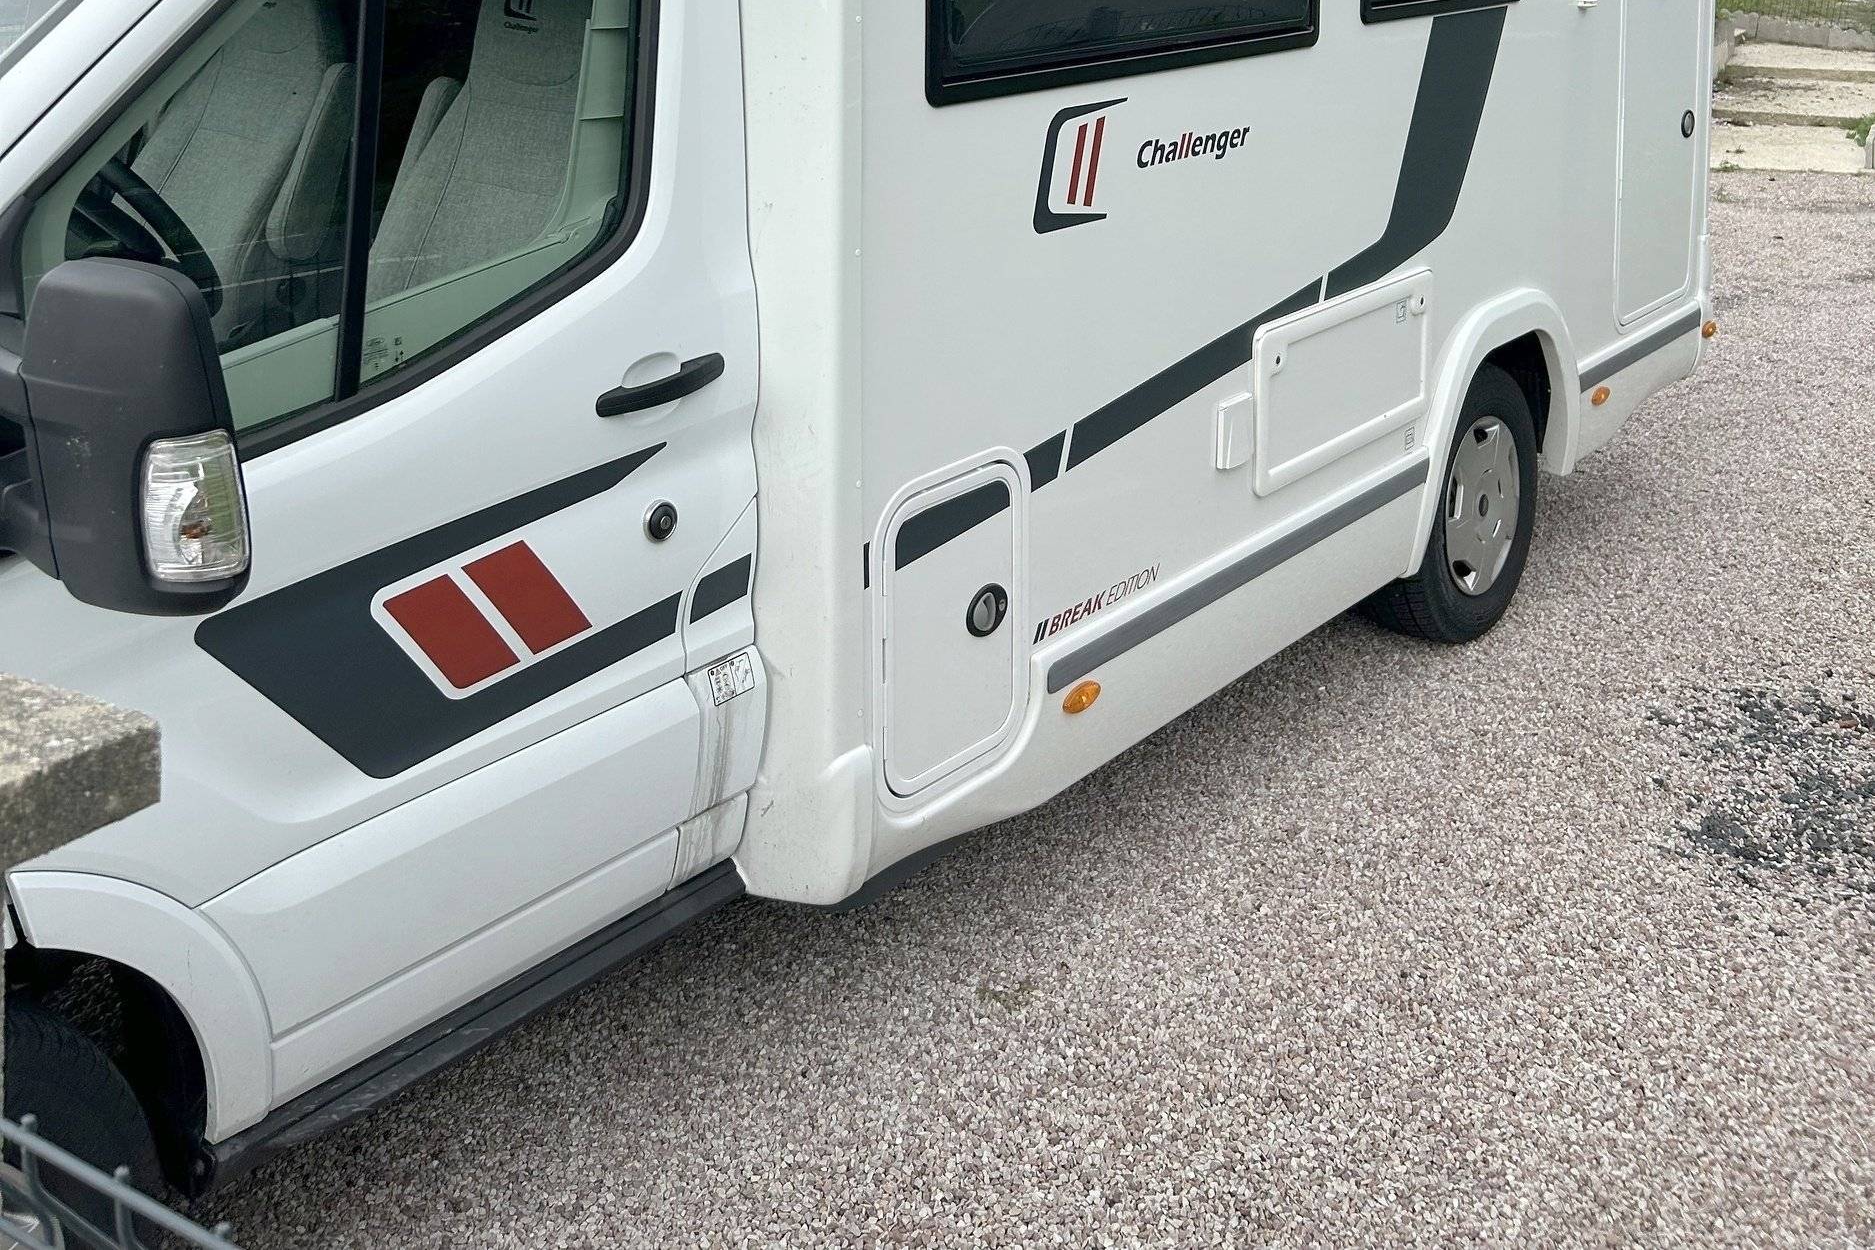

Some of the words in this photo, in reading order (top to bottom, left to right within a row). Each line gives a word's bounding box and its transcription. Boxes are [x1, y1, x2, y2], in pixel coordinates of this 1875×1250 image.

[1137, 126, 1250, 168] Challenger
[1048, 590, 1107, 636] BREAK
[1106, 563, 1160, 606] EDITION
